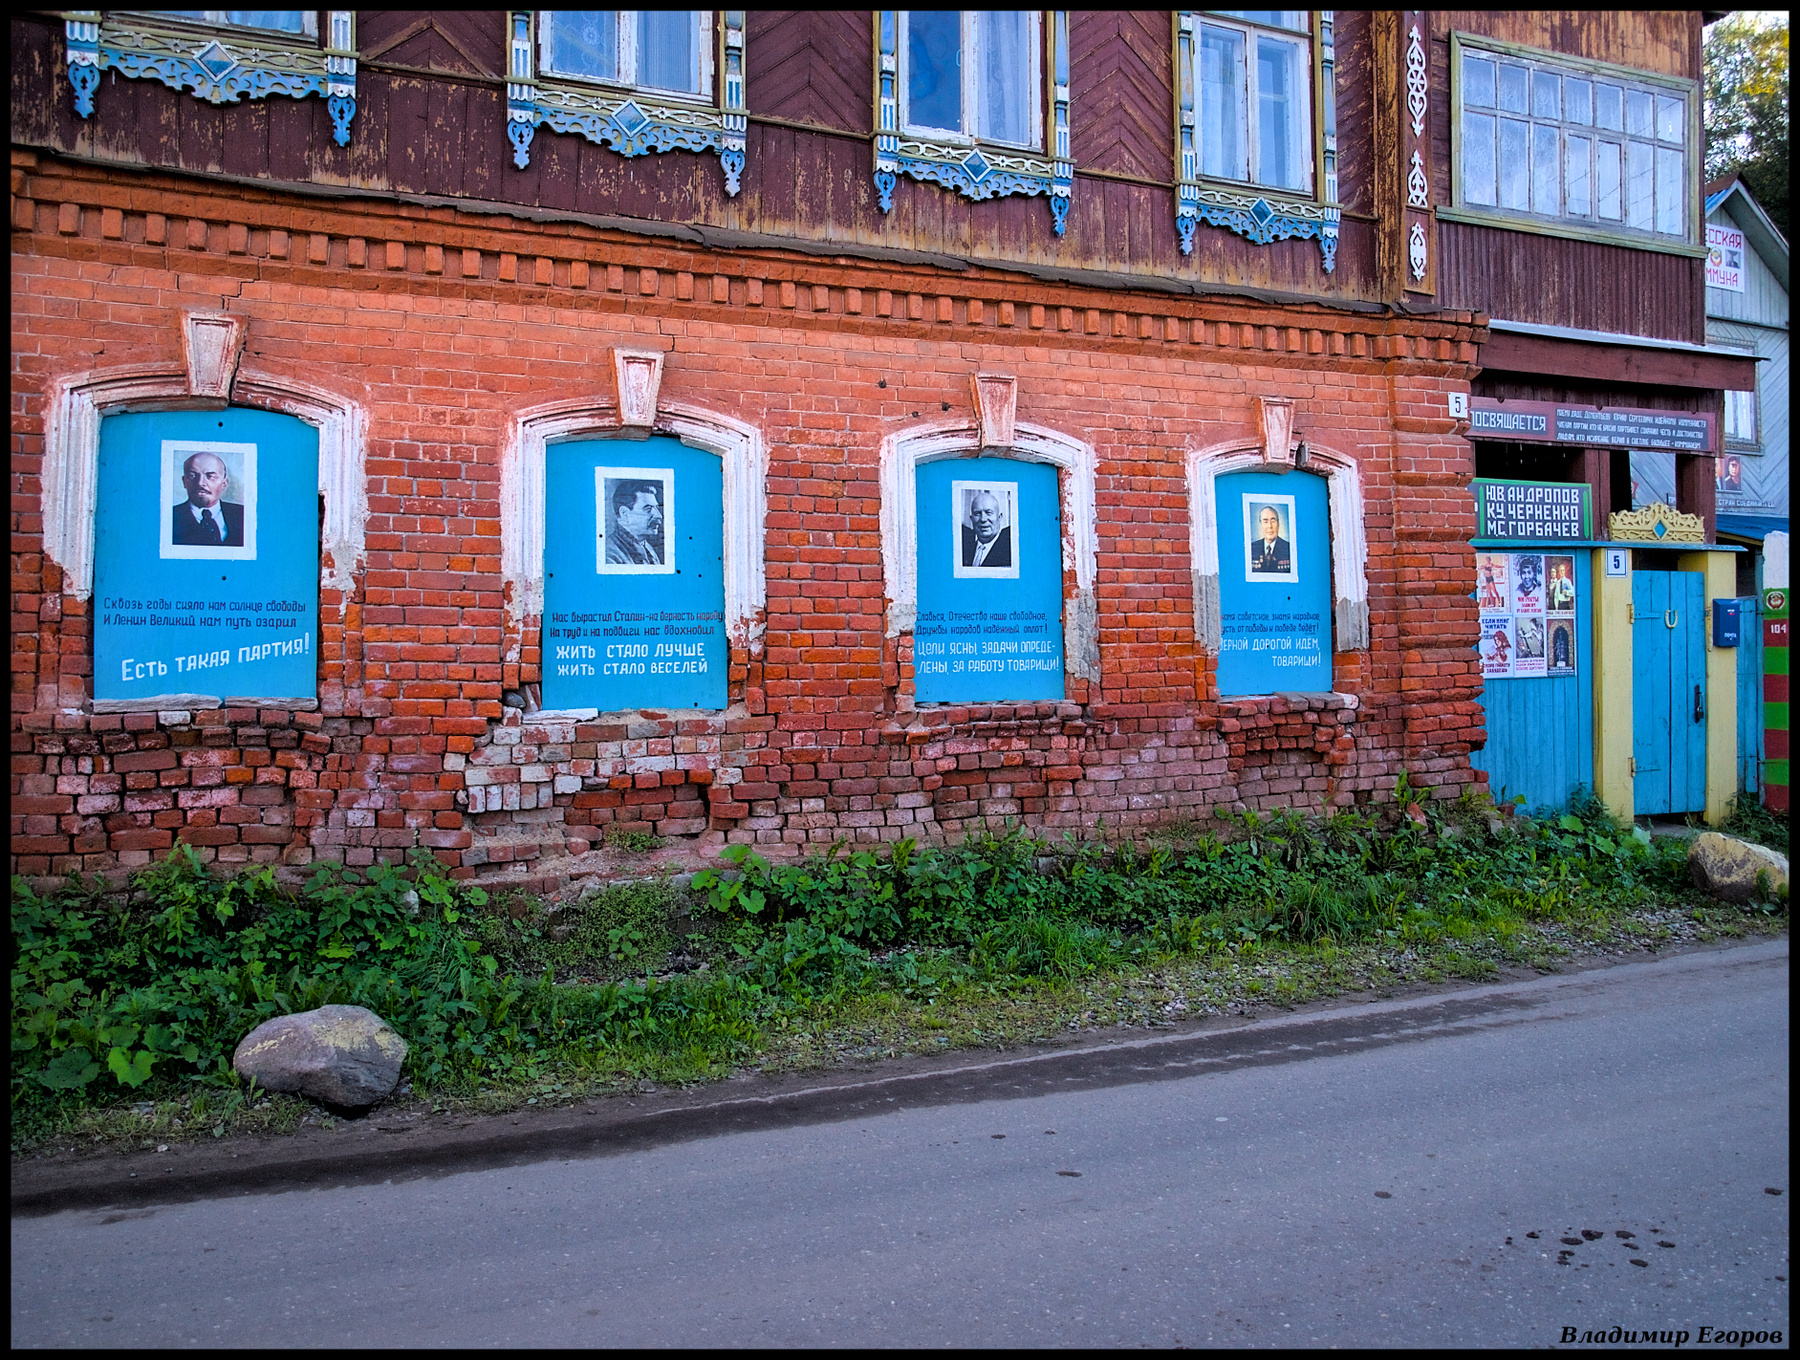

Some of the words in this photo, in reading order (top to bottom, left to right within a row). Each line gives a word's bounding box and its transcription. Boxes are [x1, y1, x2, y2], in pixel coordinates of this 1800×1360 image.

[1705, 228, 1741, 249] ССКАЯ
[1705, 268, 1738, 287] ММУНА
[1455, 396, 1461, 413] 5
[1507, 486, 1579, 503] АНДРОПОВ
[1507, 503, 1579, 520] ЧЕРНЕНКО
[1508, 521, 1579, 537] ГОРБАЧЕВ
[1613, 555, 1620, 570] 5
[104, 598, 143, 610] Сквозь
[146, 599, 172, 610] годы
[176, 600, 205, 610] сияло
[208, 601, 226, 611] нам
[229, 601, 262, 613] солнце
[266, 600, 306, 612] свободы
[104, 615, 111, 625] И
[114, 614, 146, 626] Ленин
[150, 614, 195, 626] Великий
[200, 616, 221, 627] нам
[226, 617, 252, 630] путь
[256, 617, 296, 630] озарил
[552, 612, 568, 622] Нас
[572, 611, 612, 624] вырастил
[660, 611, 694, 622] верность
[697, 610, 723, 623] народу
[949, 611, 988, 621] Отечество
[990, 613, 1007, 621] наше
[1009, 611, 1048, 622] свободное,
[1272, 613, 1291, 621] знамя
[550, 627, 560, 637] На
[562, 627, 581, 639] труд
[590, 628, 600, 636] на
[603, 626, 640, 637] подвиги
[644, 627, 660, 636] нас
[664, 625, 714, 635] вдохновил
[916, 625, 947, 636] Дружбы
[951, 624, 981, 636] народов
[1221, 625, 1235, 635] усть
[1237, 625, 1244, 633] от
[1275, 623, 1296, 632] победе
[1771, 624, 1786, 634] 104
[556, 646, 596, 659] ЖИТЬ
[607, 644, 648, 658] СТАЛО
[654, 643, 705, 657] ЛУЧШЕ
[950, 642, 978, 655] ЯСНЫ,
[982, 641, 1018, 654] ЗАДАЧИ
[1021, 641, 1055, 653] ОПРЕДЕ-
[1252, 636, 1292, 651] ДОРОГОЙ
[558, 664, 595, 676] ЖИТЬ
[604, 663, 645, 675] СТАЛО
[651, 658, 708, 674] ВЕСЕЛЕЙ
[918, 661, 949, 675] ЛЕНЫ,
[953, 660, 965, 672] ЗА
[968, 660, 1004, 672] РАБОТУ
[1007, 656, 1059, 672] ТОВАРИЩИ!
[1272, 652, 1321, 667] ТОВАРИЩИ!
